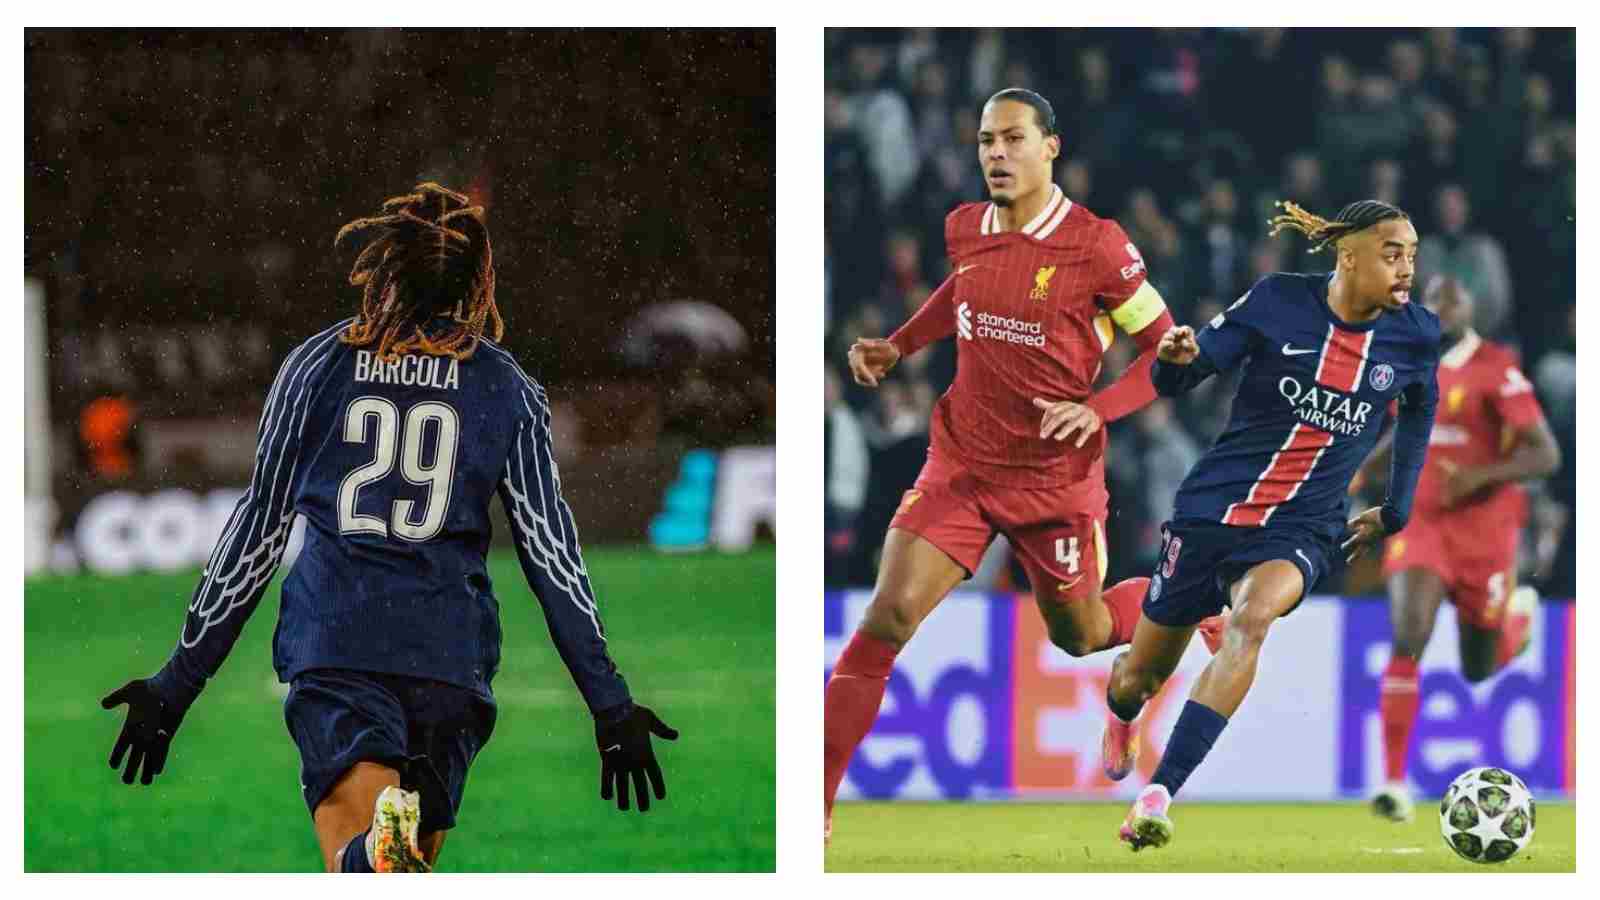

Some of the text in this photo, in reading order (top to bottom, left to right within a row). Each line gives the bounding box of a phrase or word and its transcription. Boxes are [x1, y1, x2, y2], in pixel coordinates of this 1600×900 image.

[976, 312, 1041, 334] standard
[976, 325, 1046, 347] chartered
[354, 350, 459, 390] BARCOLA
[1279, 376, 1373, 424] QATAR
[1293, 407, 1365, 437] AIRWAYS
[336, 396, 461, 543] 29
[1055, 536, 1081, 575] 4
[1338, 598, 1576, 800] Fed
